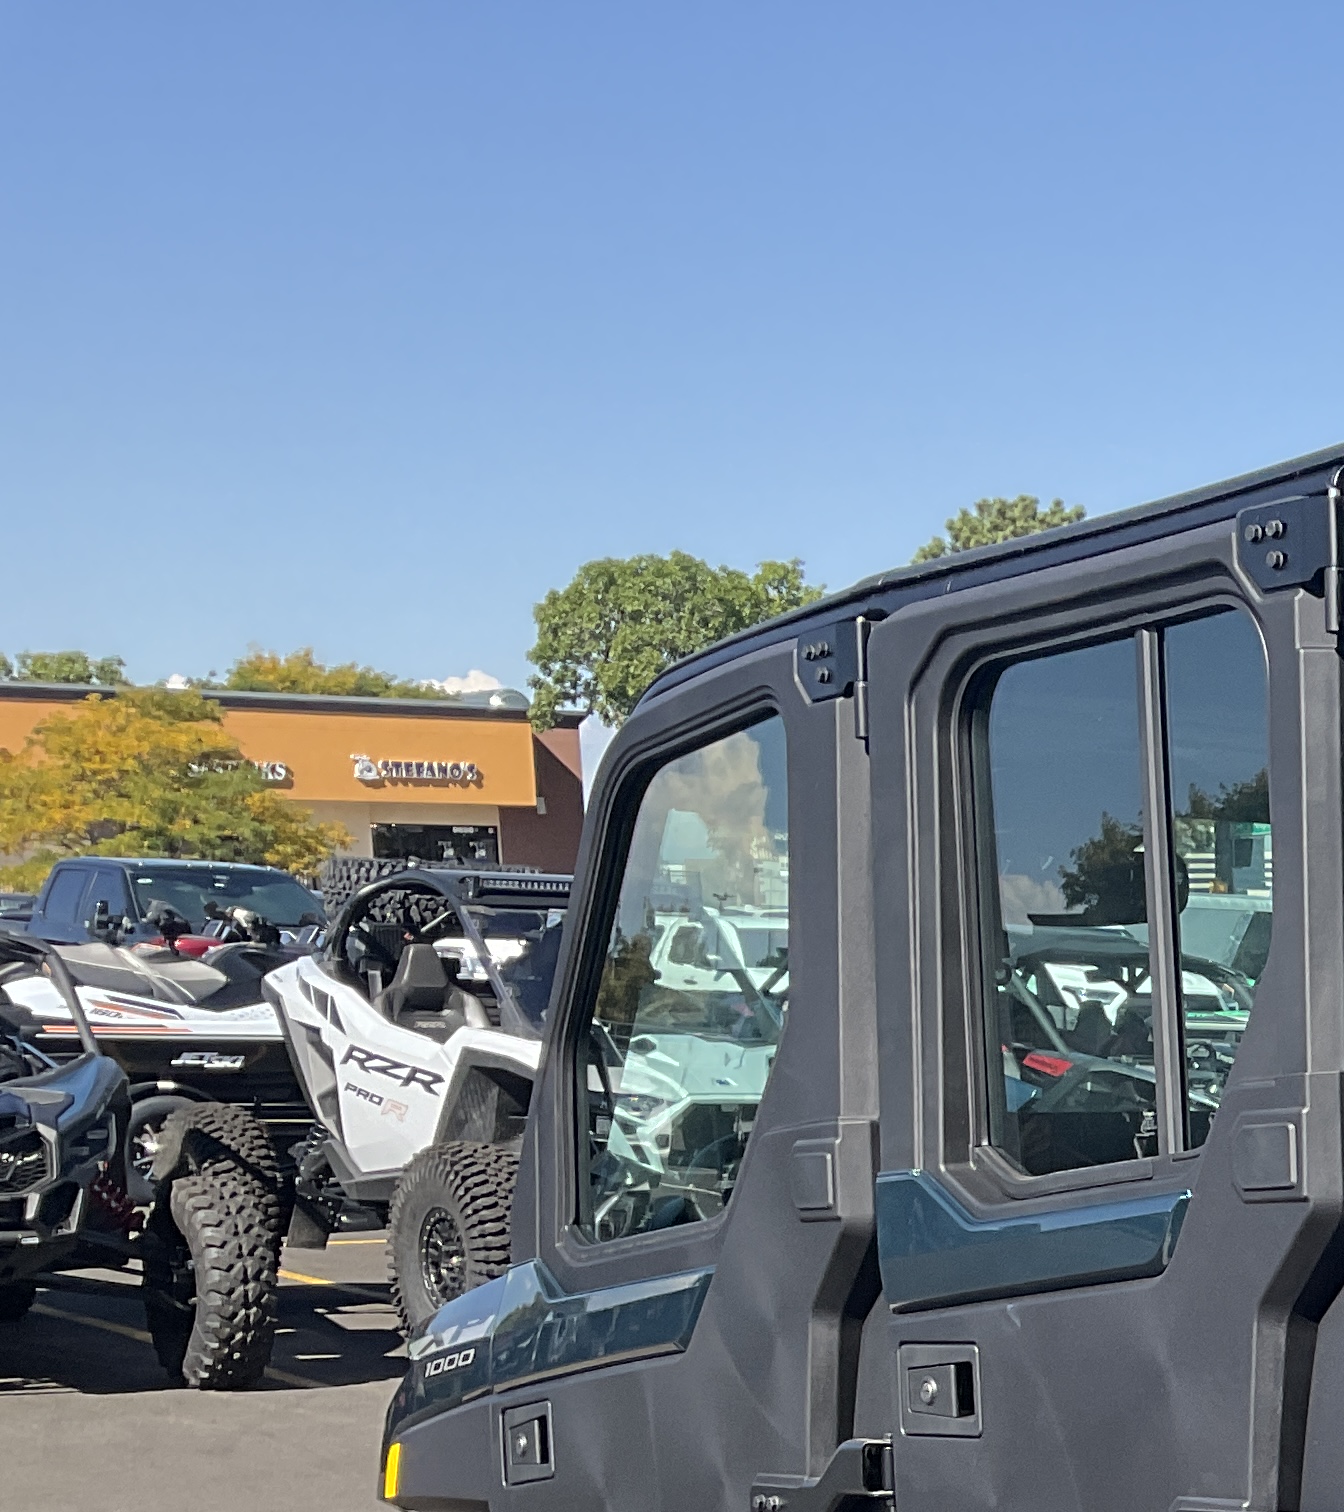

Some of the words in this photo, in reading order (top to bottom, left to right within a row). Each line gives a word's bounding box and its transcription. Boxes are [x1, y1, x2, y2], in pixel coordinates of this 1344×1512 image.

[378, 759, 477, 781] STEFANO'S
[340, 1044, 445, 1097] RZR
[344, 1082, 384, 1106] PRO
[381, 1098, 409, 1122] R
[424, 1347, 476, 1379] 1000
